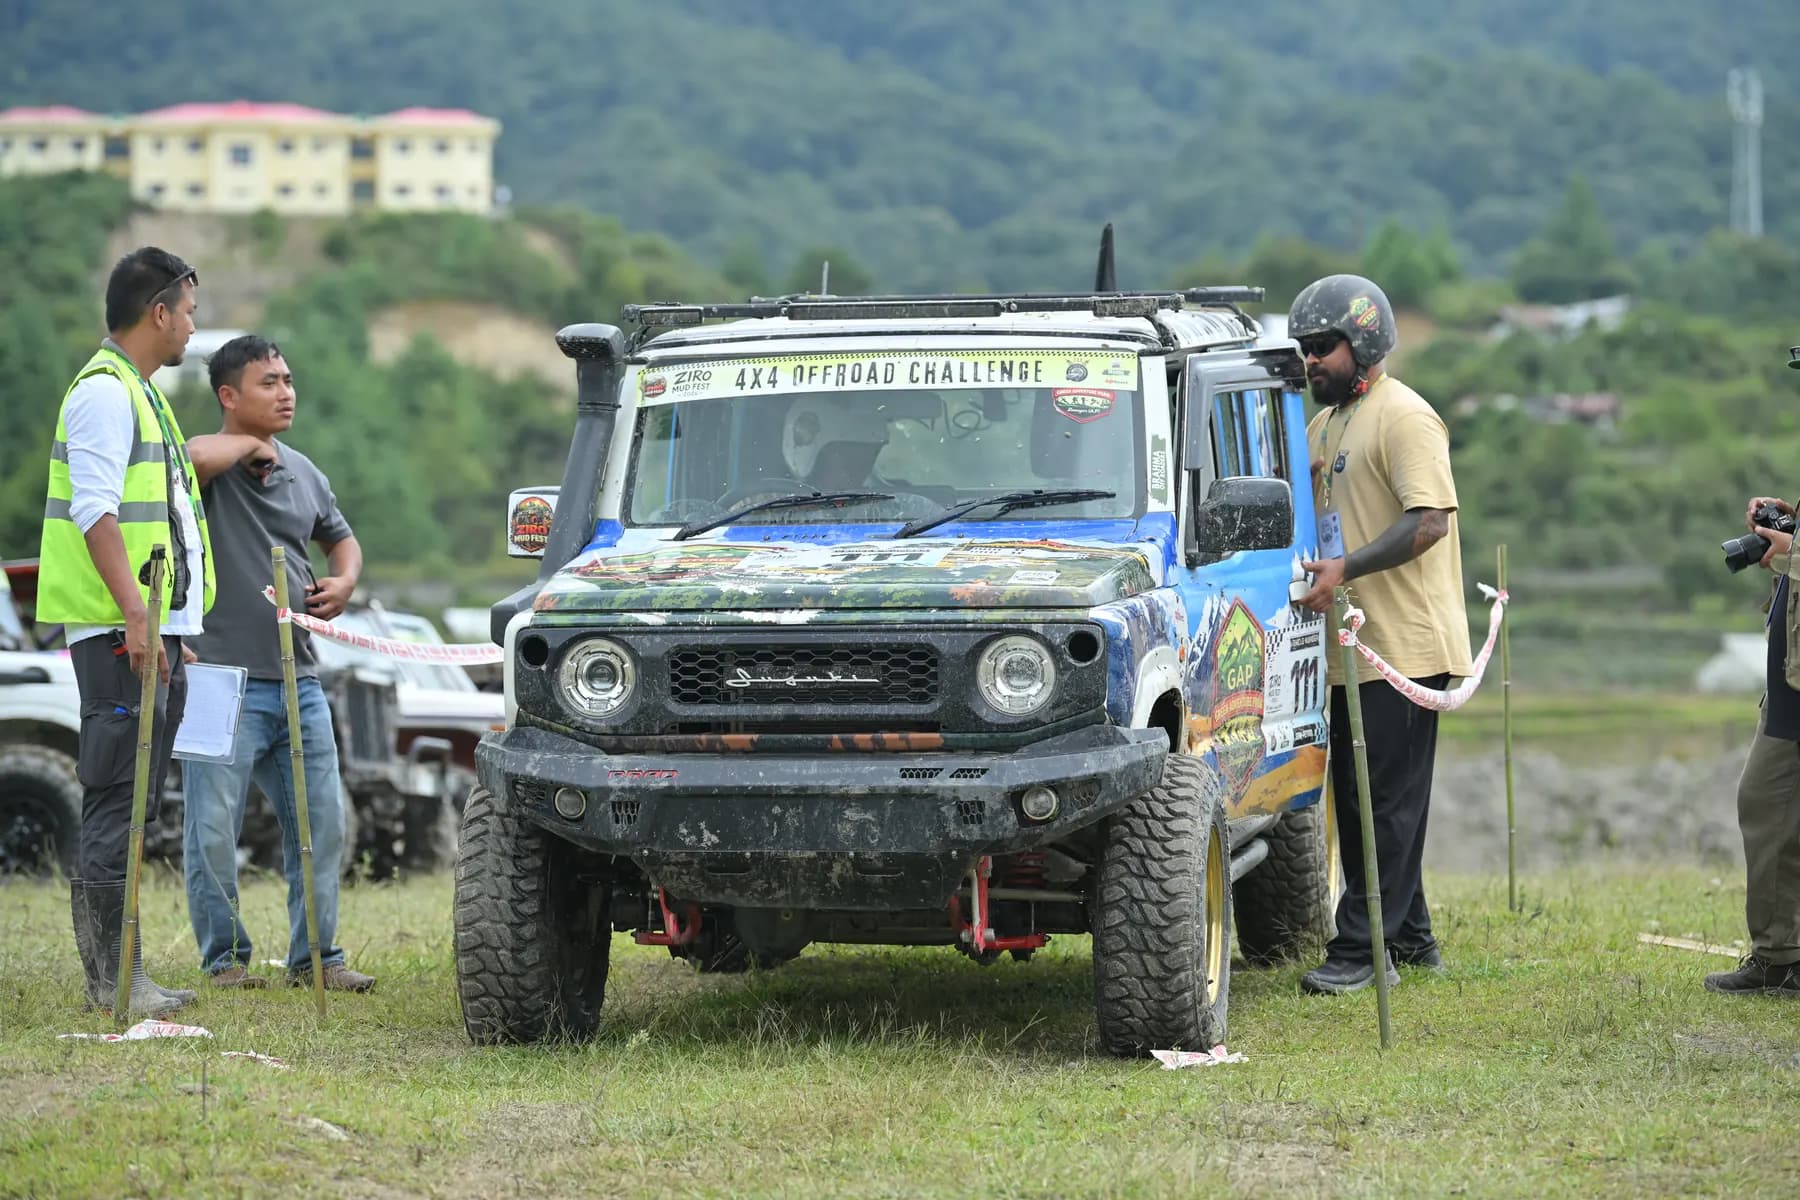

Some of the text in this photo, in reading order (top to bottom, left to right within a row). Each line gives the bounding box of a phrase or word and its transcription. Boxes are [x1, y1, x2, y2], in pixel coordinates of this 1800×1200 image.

[674, 370, 712, 385] ZIRO
[735, 366, 778, 390] 4X4
[792, 362, 895, 387] OFFROAD
[909, 360, 1043, 385] CHALLENGE
[672, 384, 691, 394] MUD
[692, 382, 711, 391] FEST
[1152, 451, 1161, 489] BRAHMA
[514, 534, 548, 543] MUD FEST
[515, 524, 549, 535] ZIRO
[1227, 664, 1253, 690] GAP
[1290, 655, 1319, 713] 111
